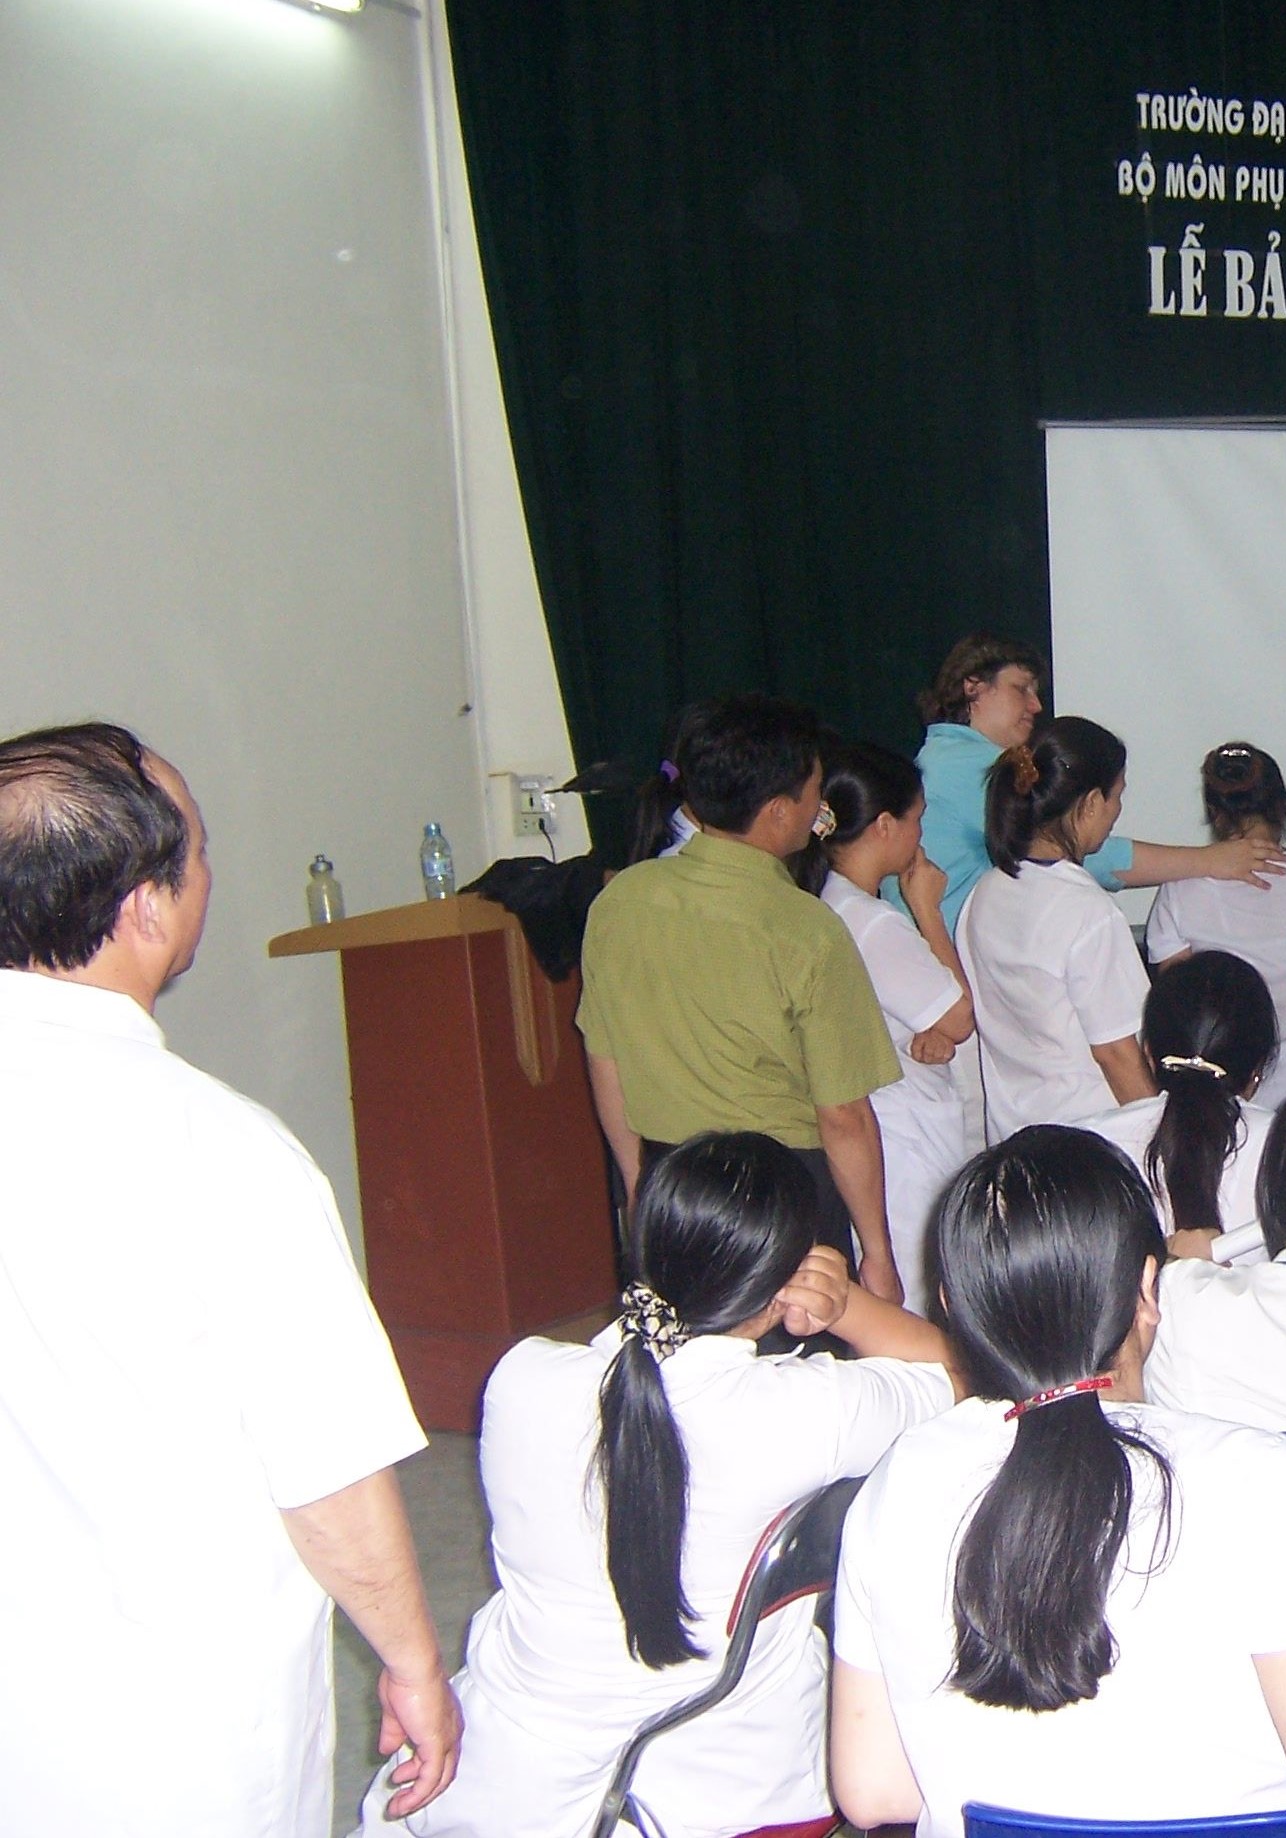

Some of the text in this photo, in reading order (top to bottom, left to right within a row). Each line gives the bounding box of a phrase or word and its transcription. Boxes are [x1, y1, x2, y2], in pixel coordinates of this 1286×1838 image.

[1136, 86, 1245, 135] TRƯỜNG
[1118, 151, 1156, 204] BỘ
[1165, 153, 1226, 201] MÔN
[1147, 222, 1208, 317] LỄ
